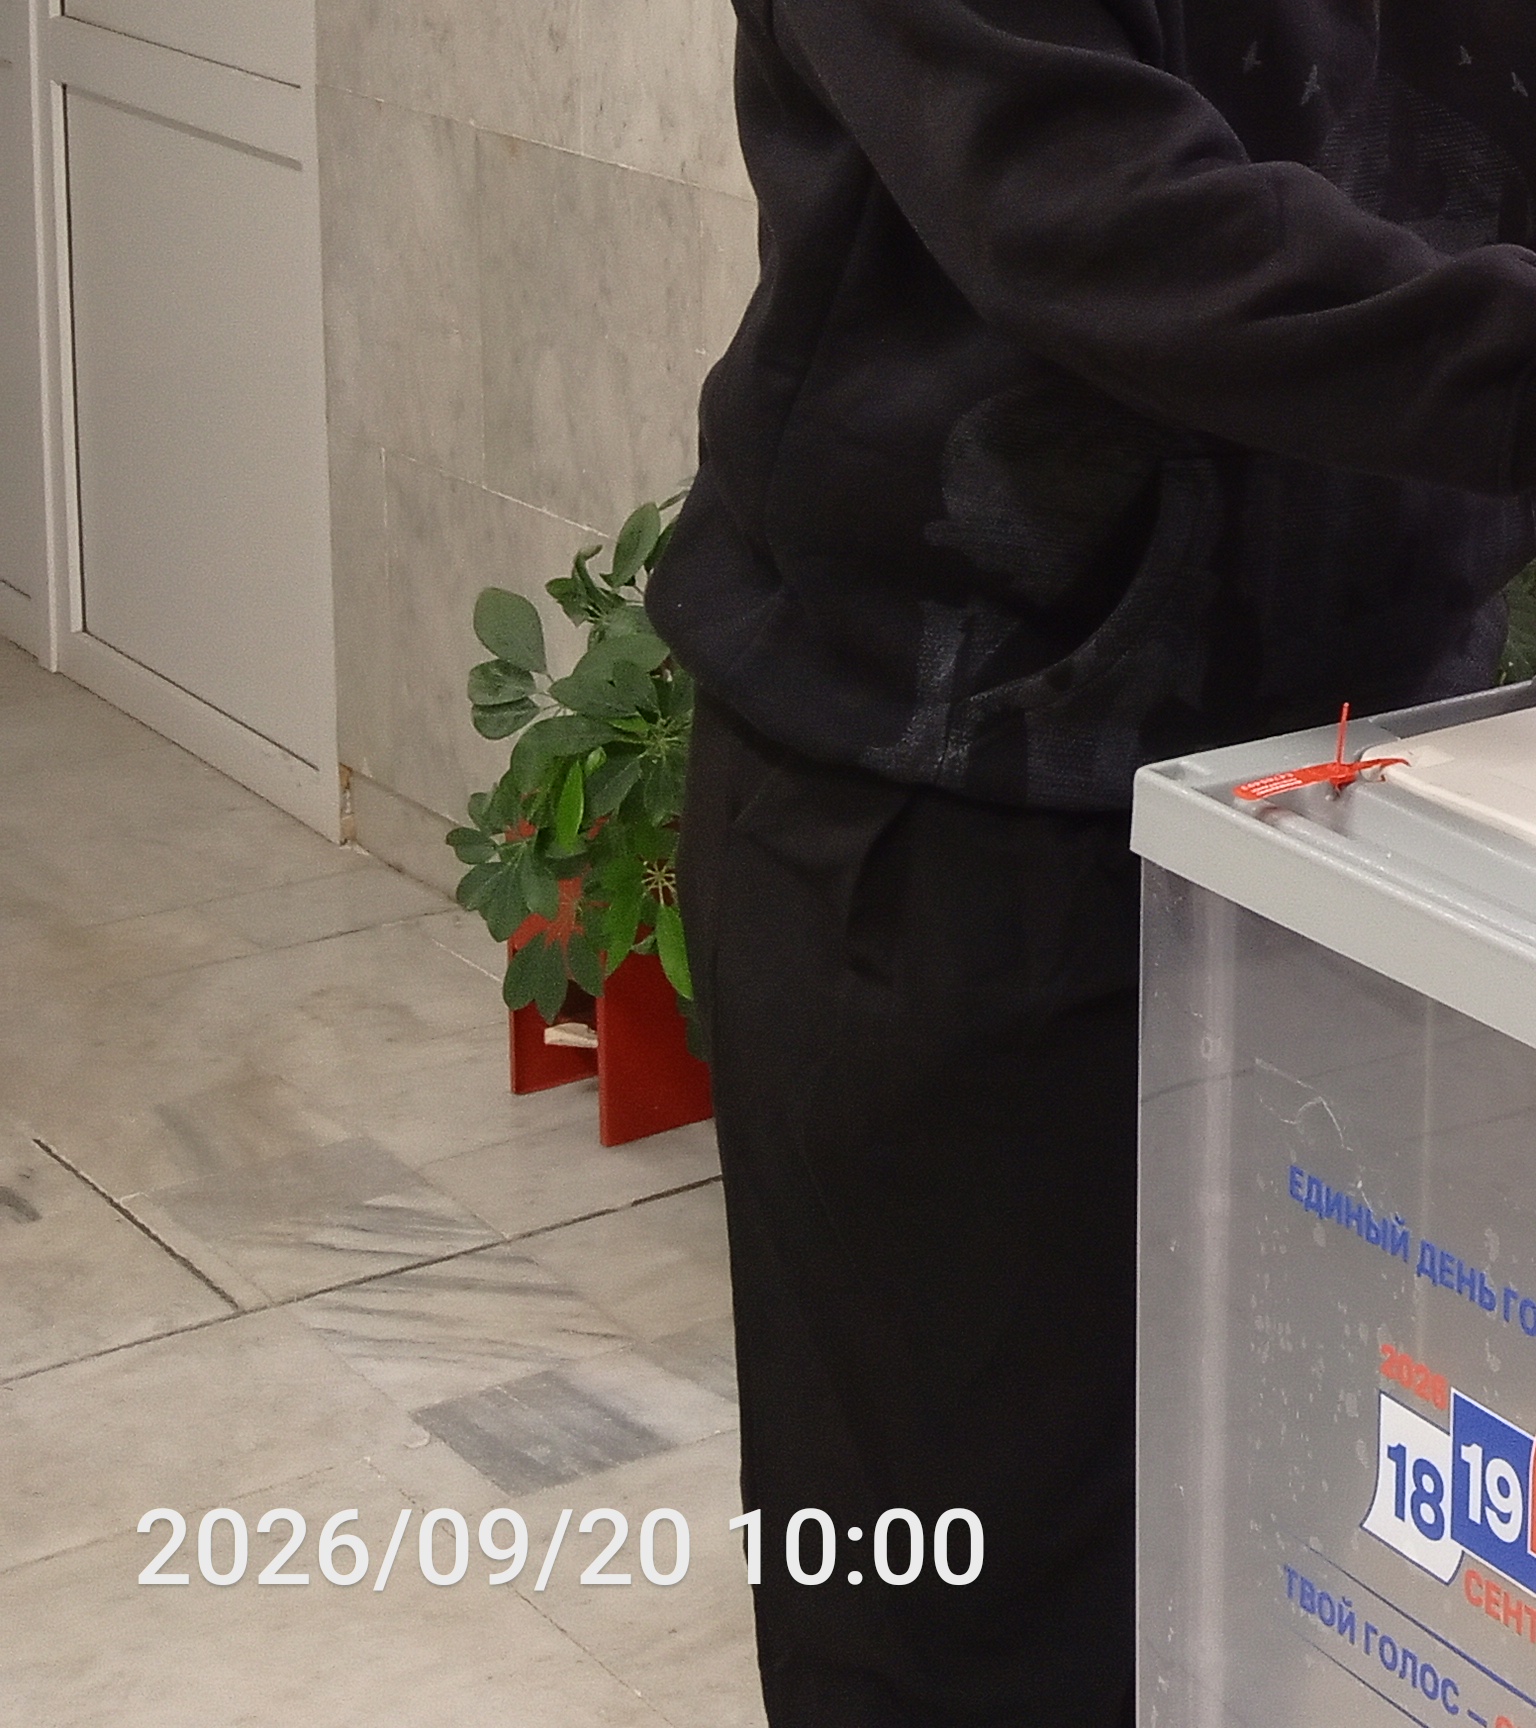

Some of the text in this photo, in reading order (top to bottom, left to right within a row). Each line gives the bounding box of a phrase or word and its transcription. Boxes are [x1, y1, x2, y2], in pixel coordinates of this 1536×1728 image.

[1288, 1164, 1411, 1264] ЕДИНЫЙ
[1416, 1239, 1498, 1312] ДЕНЬ
[1386, 1442, 1445, 1542] 18
[1461, 1443, 1524, 1543] 19
[1284, 1563, 1356, 1646] ТВОЙ
[1364, 1621, 1460, 1716] ГОЛОС
